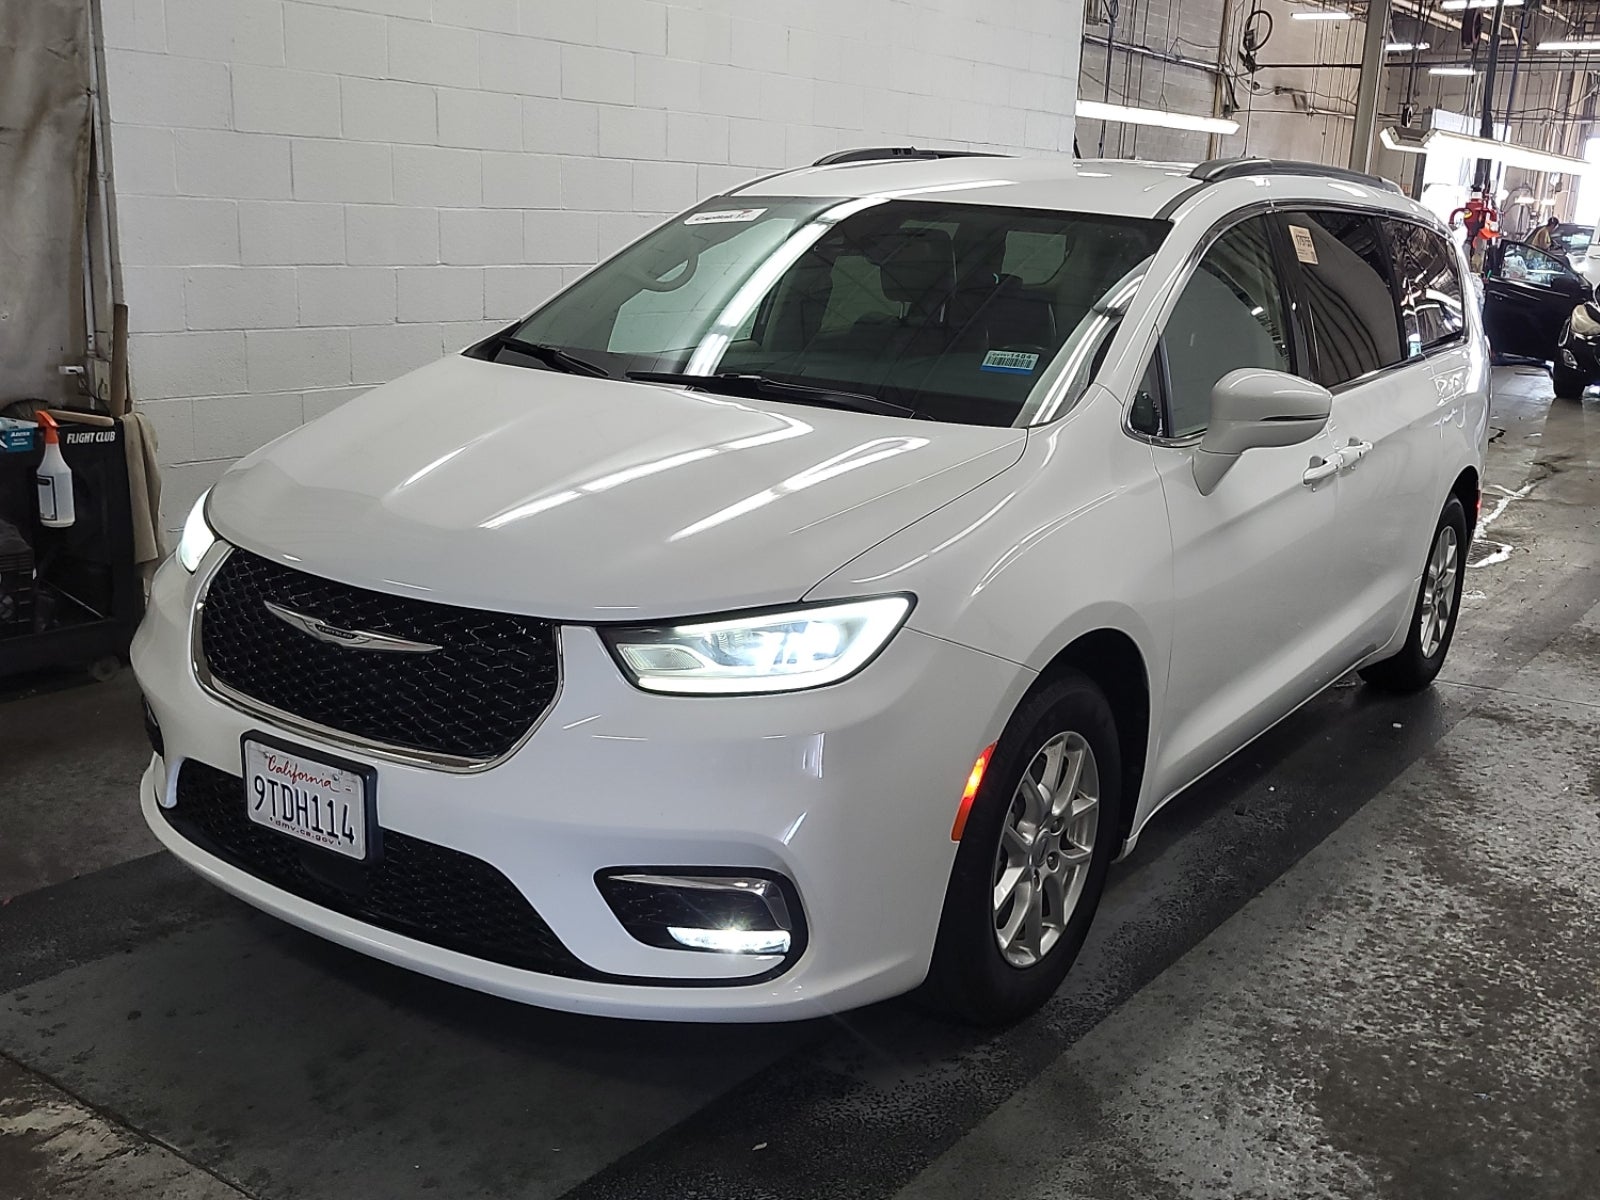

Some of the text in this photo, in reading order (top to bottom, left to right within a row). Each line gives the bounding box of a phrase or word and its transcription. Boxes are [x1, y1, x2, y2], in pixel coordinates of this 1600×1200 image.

[66, 431, 116, 444] FLIGHT CLUB
[268, 755, 340, 793] California
[254, 775, 355, 845] 9TDH114
[275, 820, 335, 845] dmv.ca.gov
